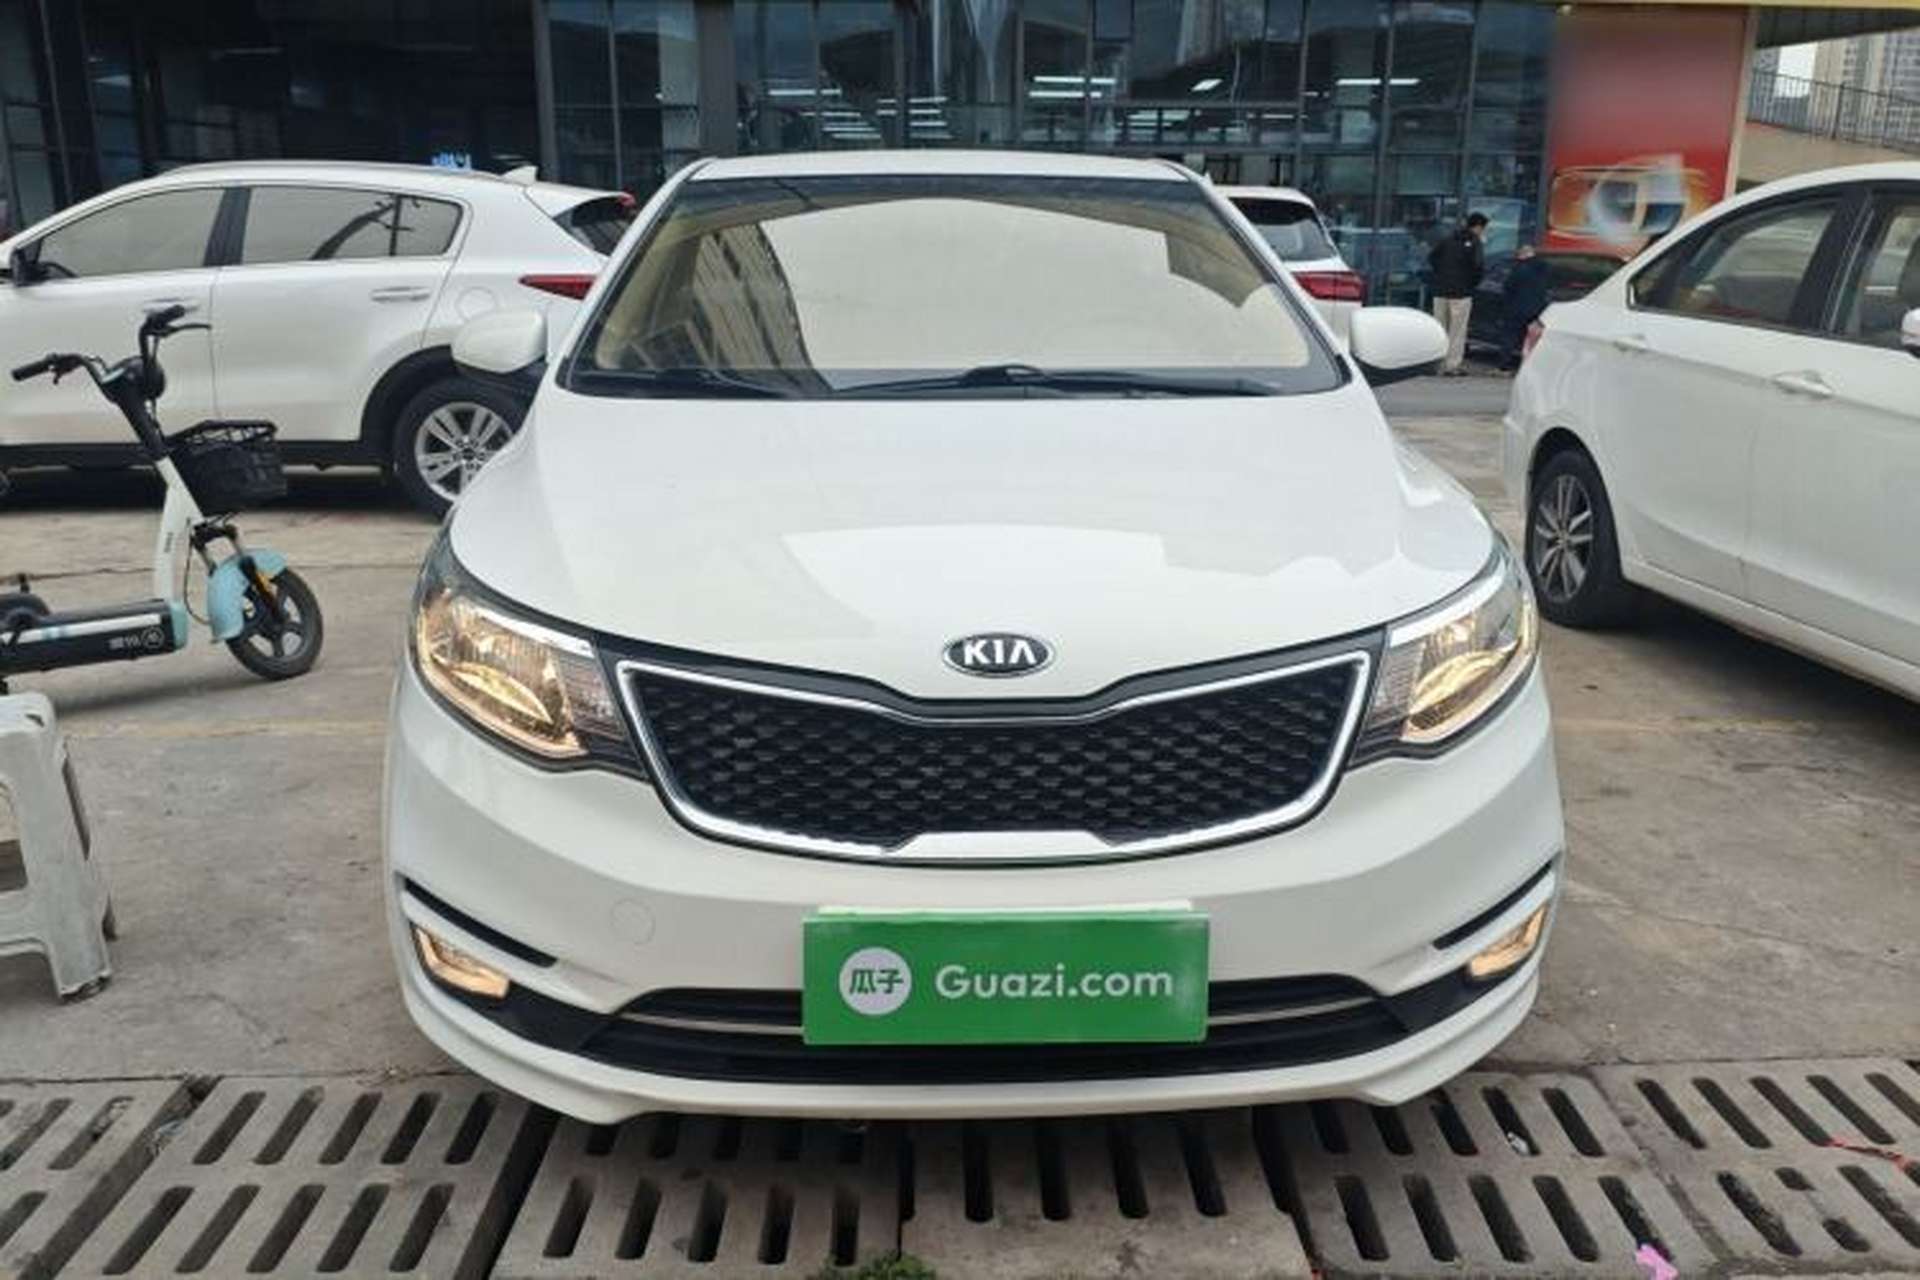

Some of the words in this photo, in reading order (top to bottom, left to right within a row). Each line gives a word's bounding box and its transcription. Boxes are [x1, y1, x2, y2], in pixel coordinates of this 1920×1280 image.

[964, 639, 1037, 665] KIA
[849, 968, 905, 995] 瓜子
[935, 962, 1173, 999] Guazi.com
